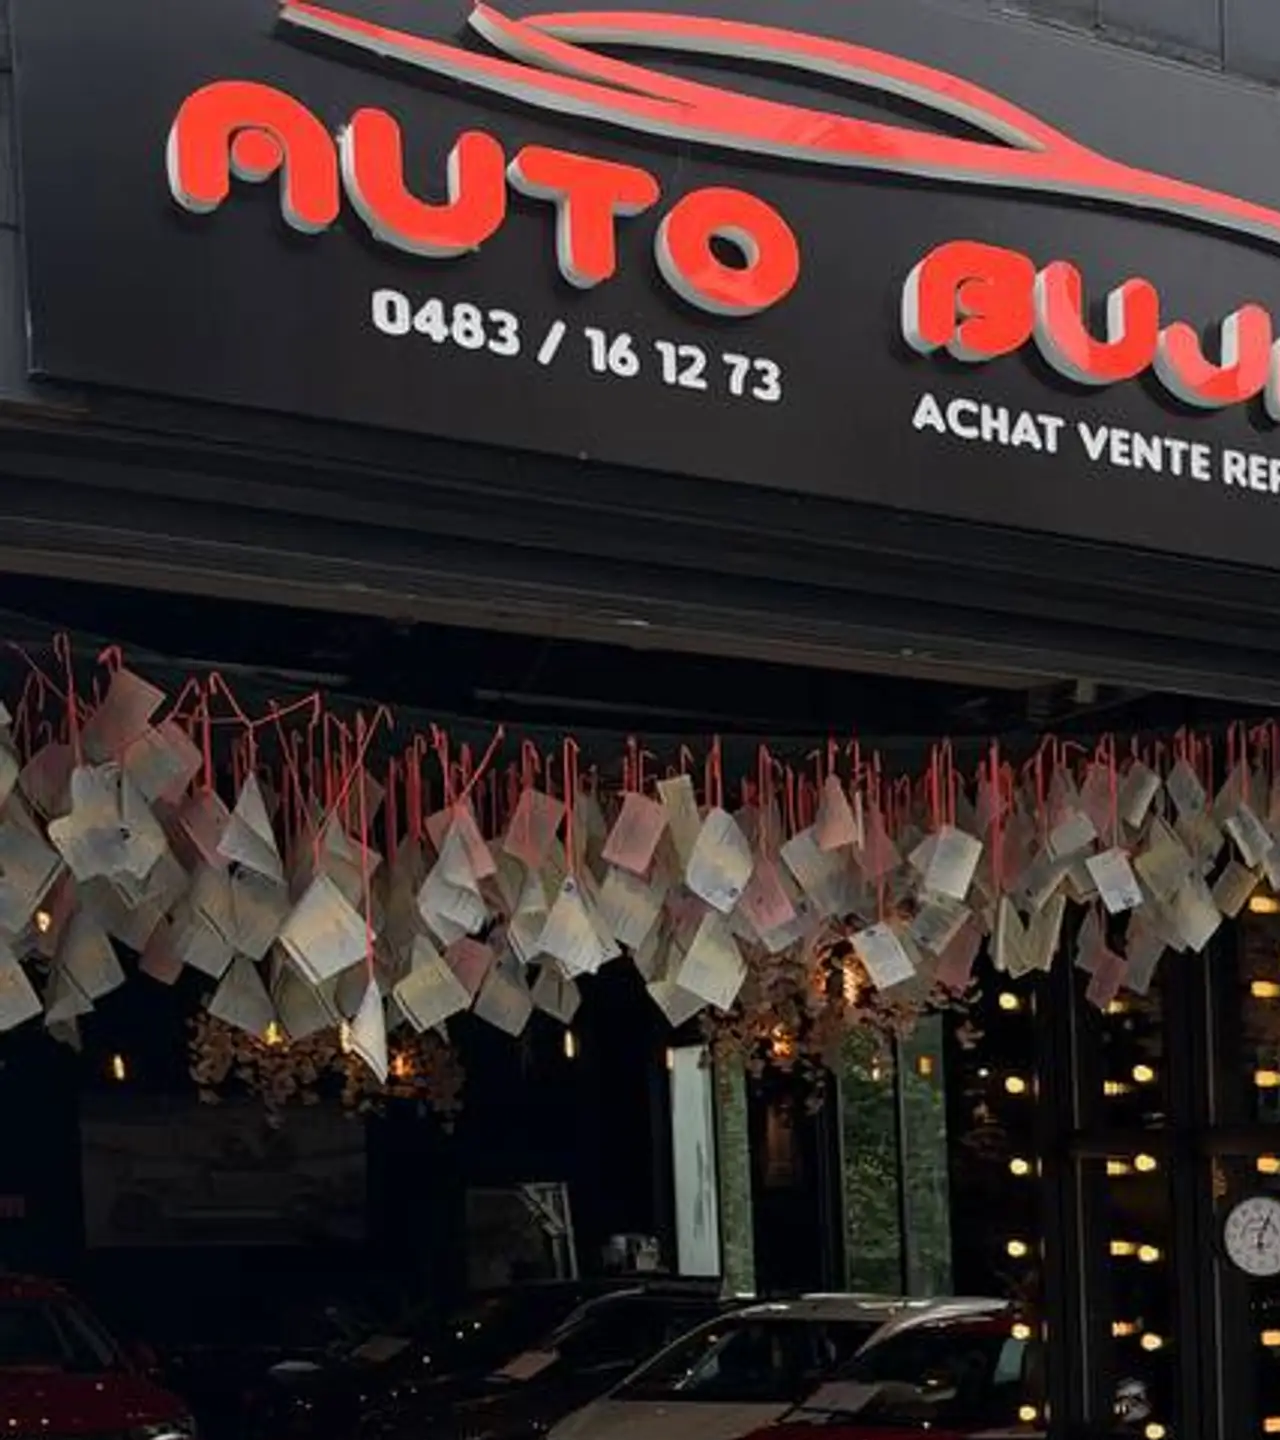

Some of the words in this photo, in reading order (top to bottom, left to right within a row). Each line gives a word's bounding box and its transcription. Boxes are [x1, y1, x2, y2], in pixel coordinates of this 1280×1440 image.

[167, 79, 801, 317] AUTO
[370, 288, 522, 356] 0483
[537, 320, 566, 366] /
[584, 326, 640, 379] 16
[653, 339, 708, 391] 12
[721, 352, 783, 403] 73
[911, 392, 1066, 454] ACHAT
[1077, 421, 1213, 482] VENTE
